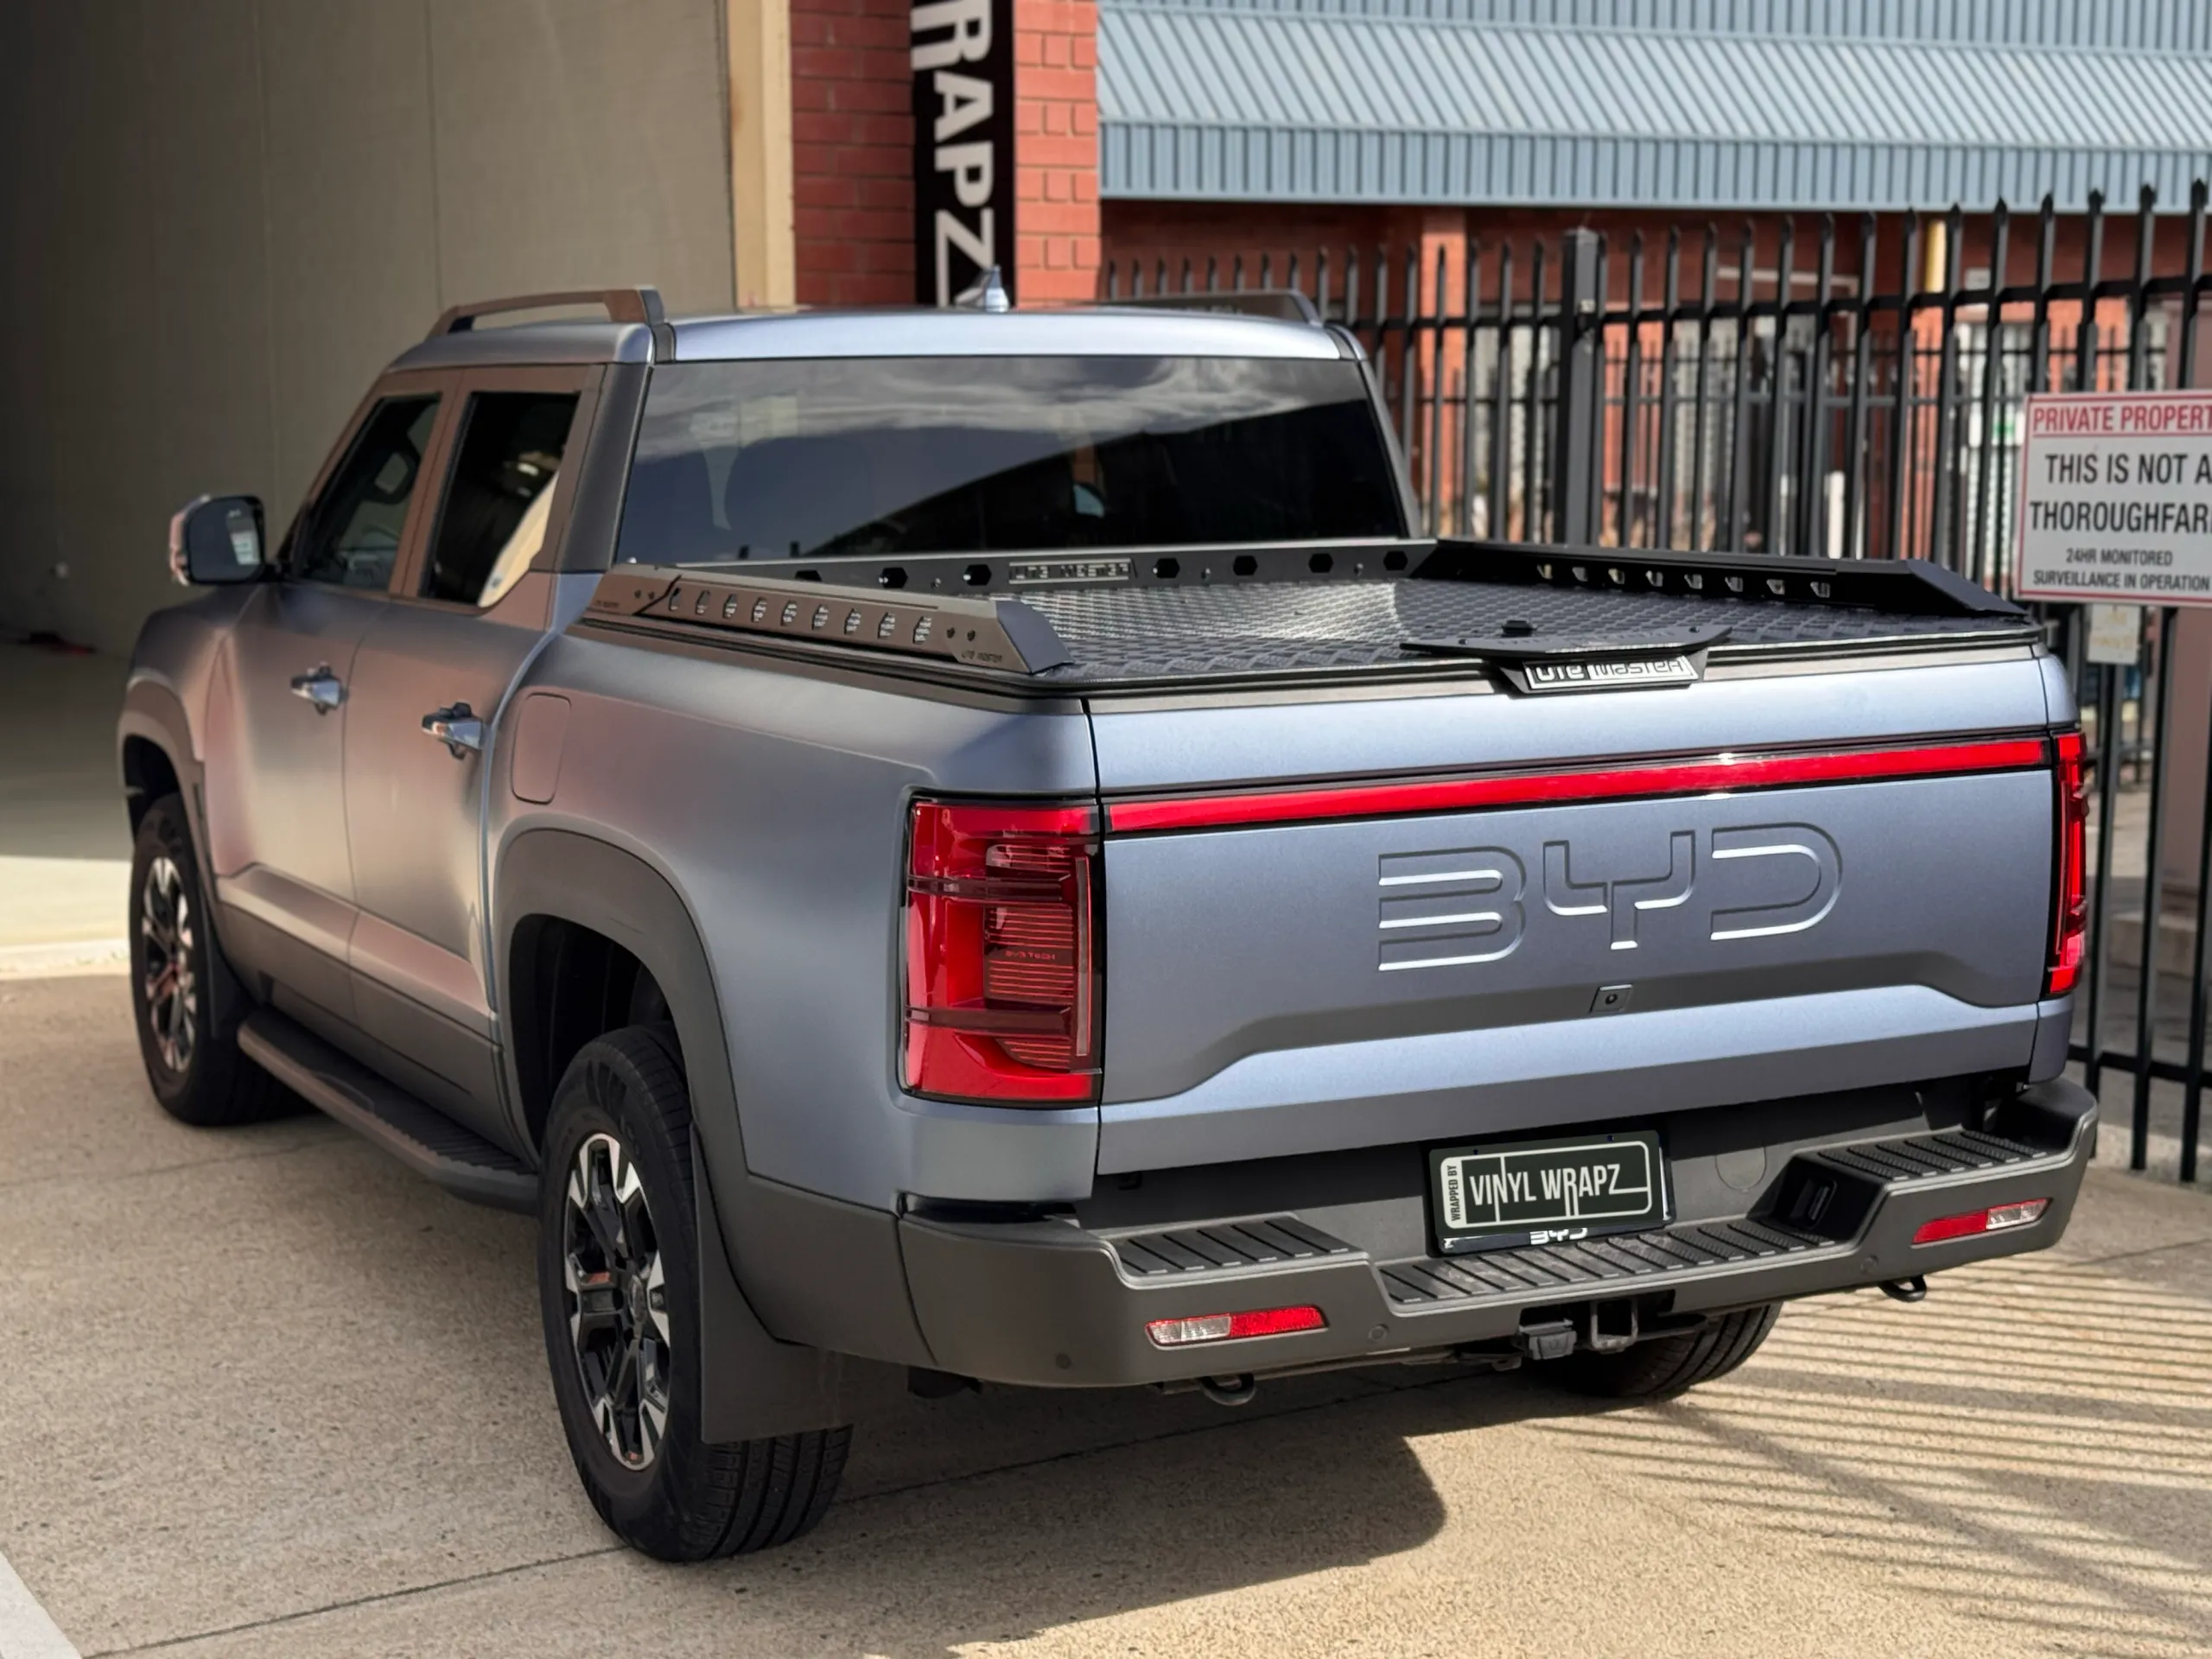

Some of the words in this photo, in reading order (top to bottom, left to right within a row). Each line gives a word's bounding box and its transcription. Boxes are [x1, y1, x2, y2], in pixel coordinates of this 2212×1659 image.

[2033, 406, 2113, 431] PRIVATE
[2045, 454, 2098, 484] THIS
[2107, 454, 2129, 484] IS
[2138, 454, 2188, 484] NOT
[2195, 453, 2212, 484] A
[2030, 500, 2212, 534] THOROUGHFAR
[2066, 548, 2096, 564] 24HR
[2101, 549, 2173, 567] MONITORED
[2033, 569, 2120, 588] SURVEILLANCE
[2124, 572, 2136, 589] IN
[2139, 572, 2209, 591] OPERATION
[1379, 822, 1843, 972] BYD
[1446, 1165, 1458, 1177] BY
[1448, 1179, 1462, 1222] WRAPPED
[1470, 1162, 1536, 1214] VINYL
[1541, 1164, 1624, 1208] WRAPZ
[1529, 1227, 1587, 1245] BYD
